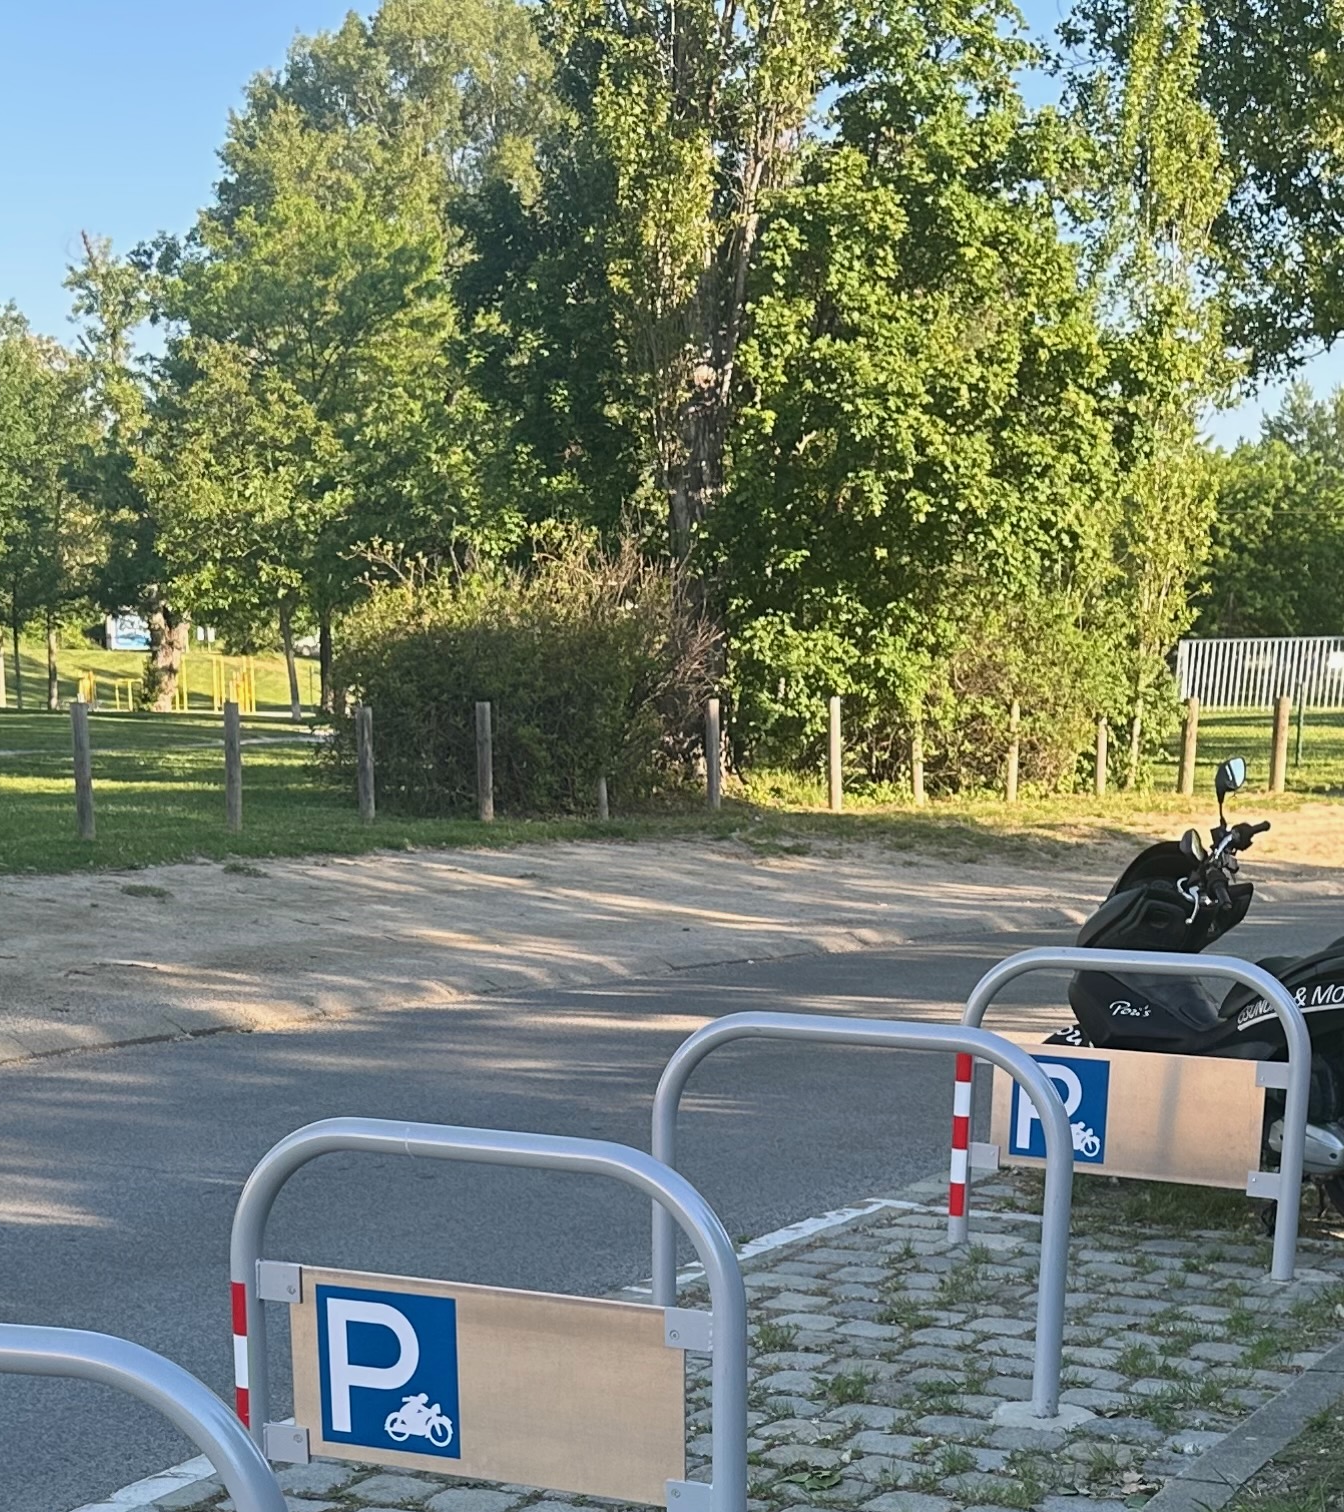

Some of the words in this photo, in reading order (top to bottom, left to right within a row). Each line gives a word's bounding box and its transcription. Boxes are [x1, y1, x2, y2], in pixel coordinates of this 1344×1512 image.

[1294, 986, 1307, 1007] &
[1015, 1062, 1083, 1150] P
[326, 1296, 420, 1433] P
